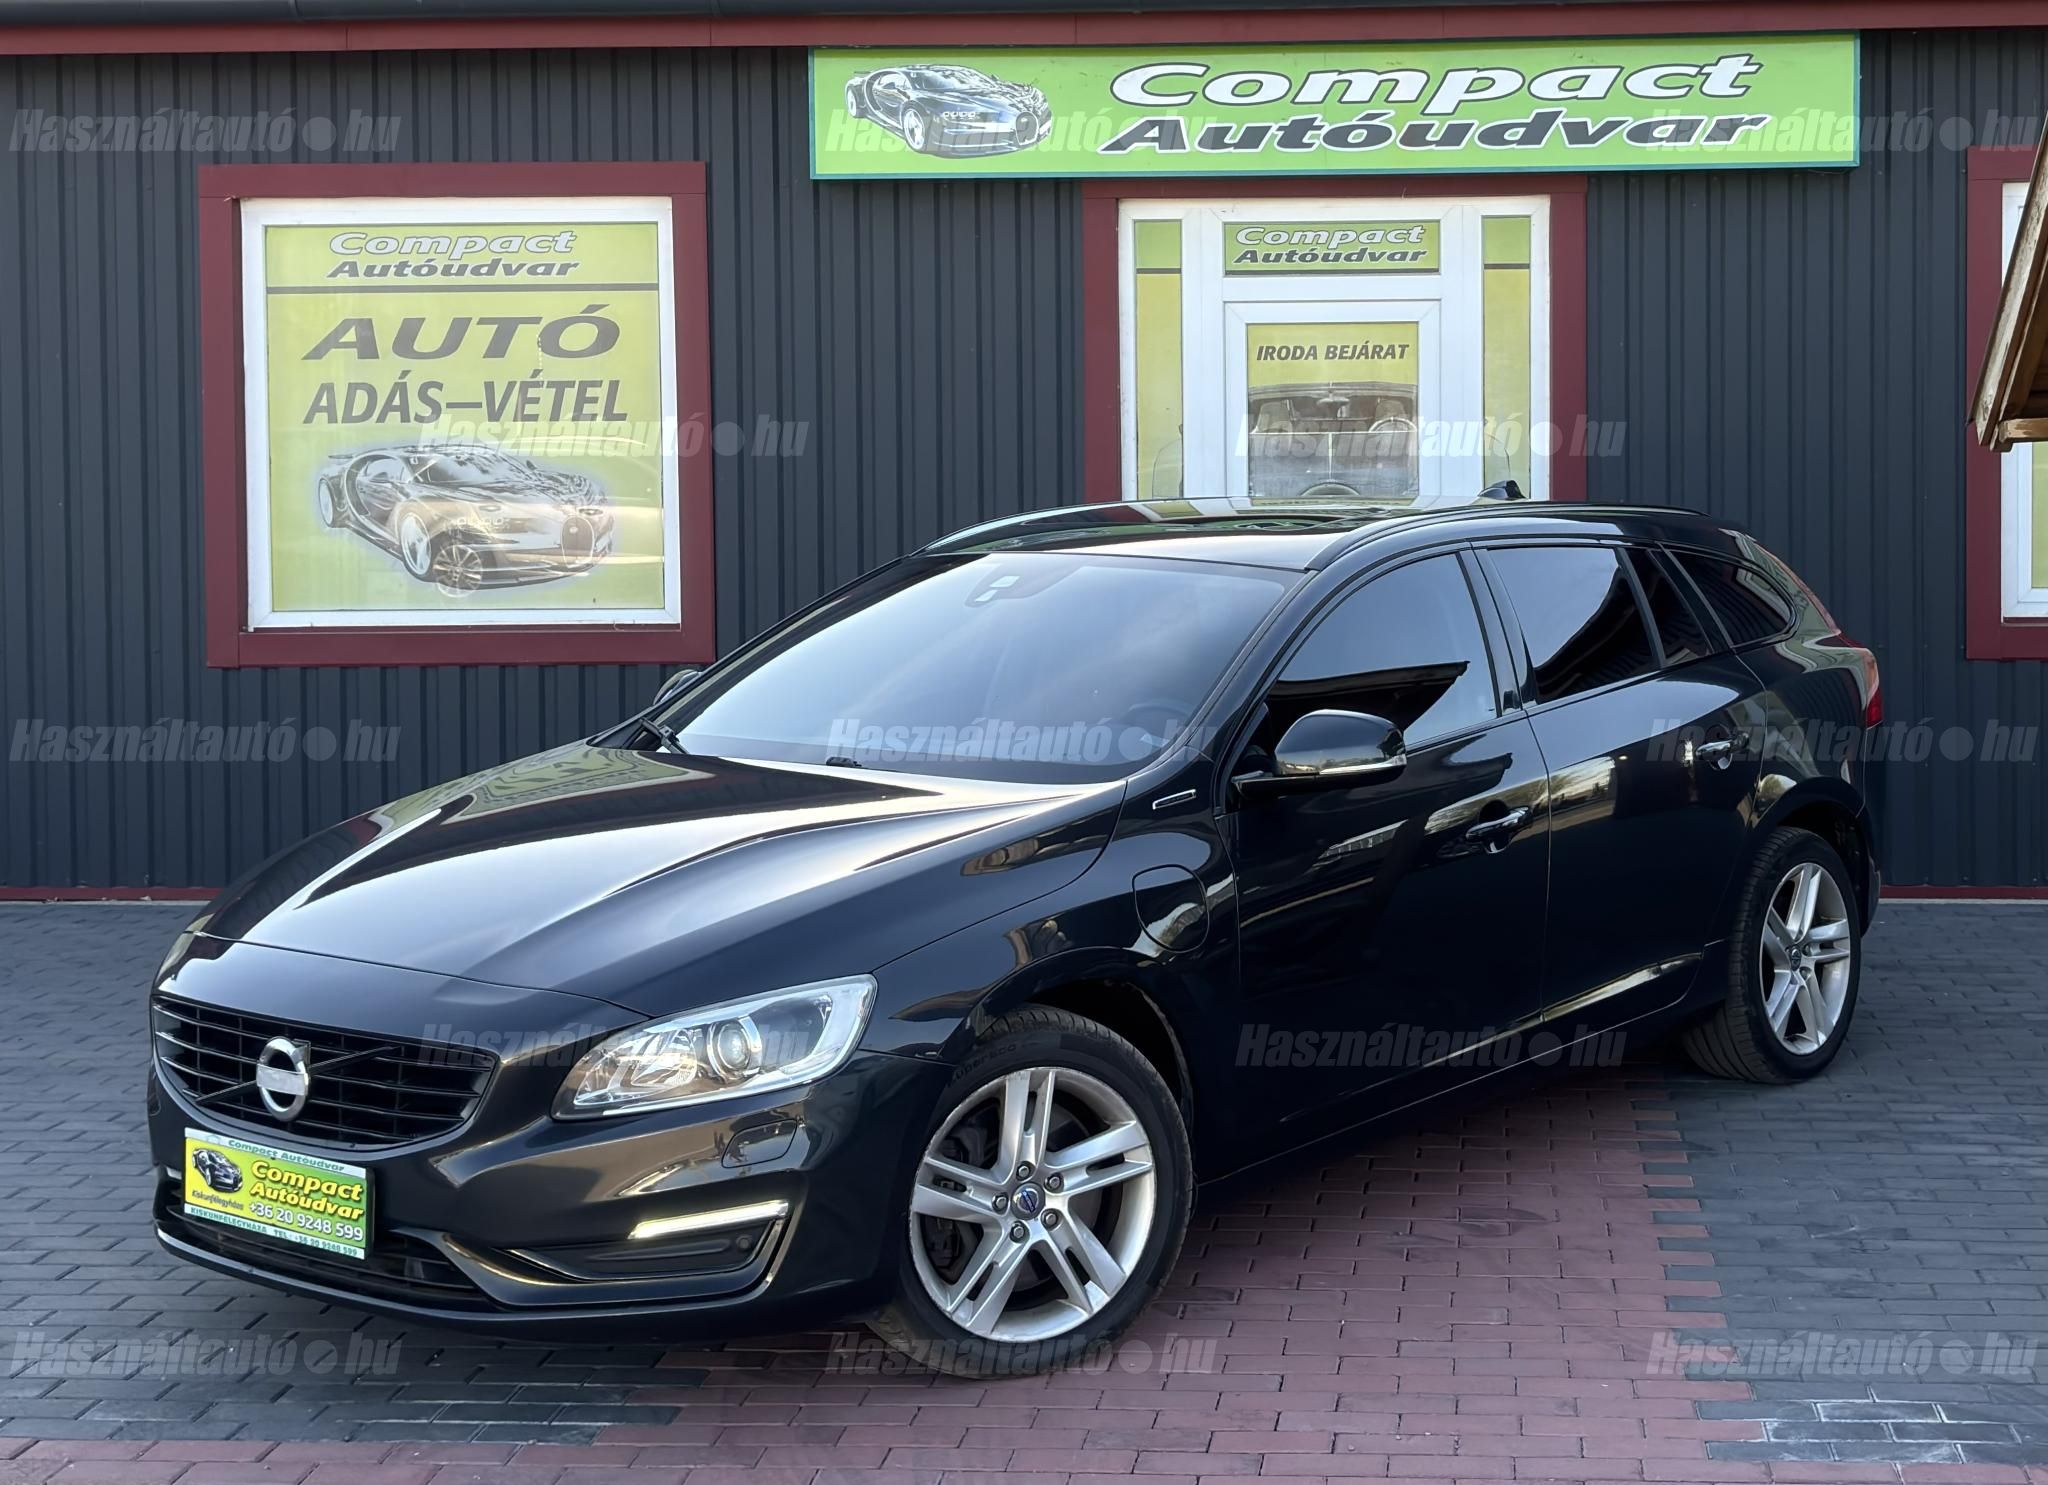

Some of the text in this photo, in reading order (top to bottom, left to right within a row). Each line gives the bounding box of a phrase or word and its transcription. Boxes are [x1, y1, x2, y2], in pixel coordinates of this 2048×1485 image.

[1110, 53, 1763, 115] Compact
[1097, 107, 1771, 154] Autóudvar
[330, 230, 577, 260] Compact
[1236, 225, 1425, 250] Compact
[326, 258, 580, 278] Autóudvar
[1233, 247, 1427, 264] Autóudvar
[301, 304, 620, 361] AUTÓ
[1256, 340, 1410, 361] IRODA BEJÁRAT
[228, 1139, 278, 1157] Compact
[251, 1161, 363, 1201] Compact
[250, 1181, 364, 1220] Autóudvar
[250, 1202, 364, 1241] +36 20 9248 599
